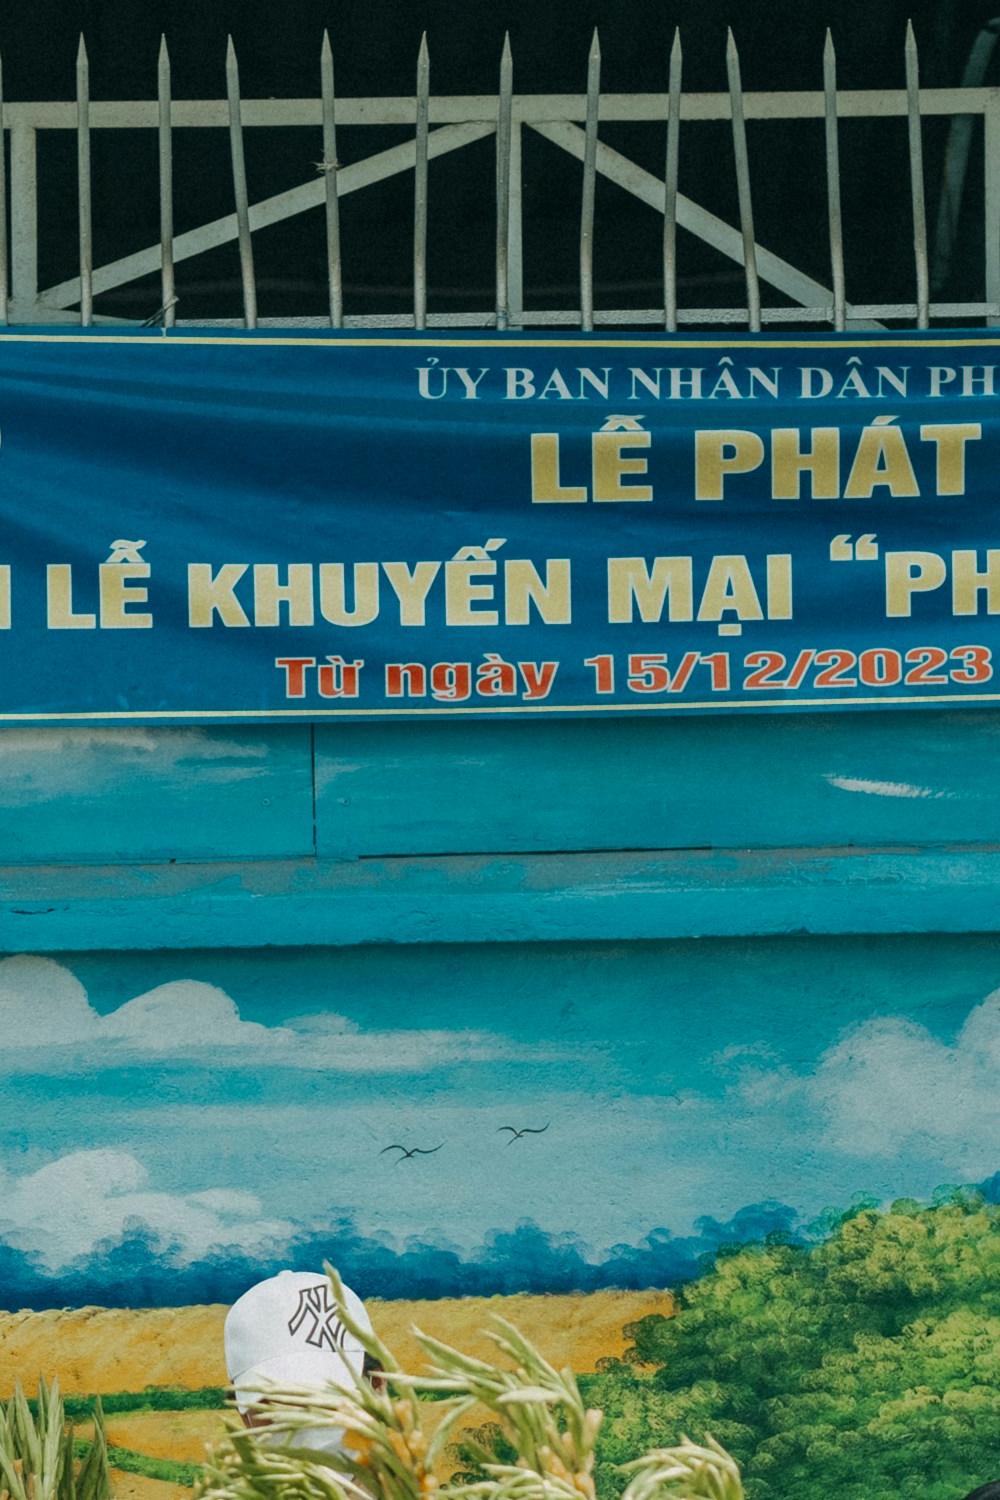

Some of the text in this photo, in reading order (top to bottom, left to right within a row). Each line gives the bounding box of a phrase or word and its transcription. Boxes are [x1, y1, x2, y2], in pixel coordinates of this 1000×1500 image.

[417, 356, 998, 401] ỦY BAN NHÂN DÂN PH
[530, 413, 981, 503] LỄ PHÁT
[46, 539, 153, 630] LỄ
[187, 538, 573, 628] KHUYẾN
[607, 553, 793, 637] MẠI
[275, 645, 994, 702] Từ ngày 15/12/2023
